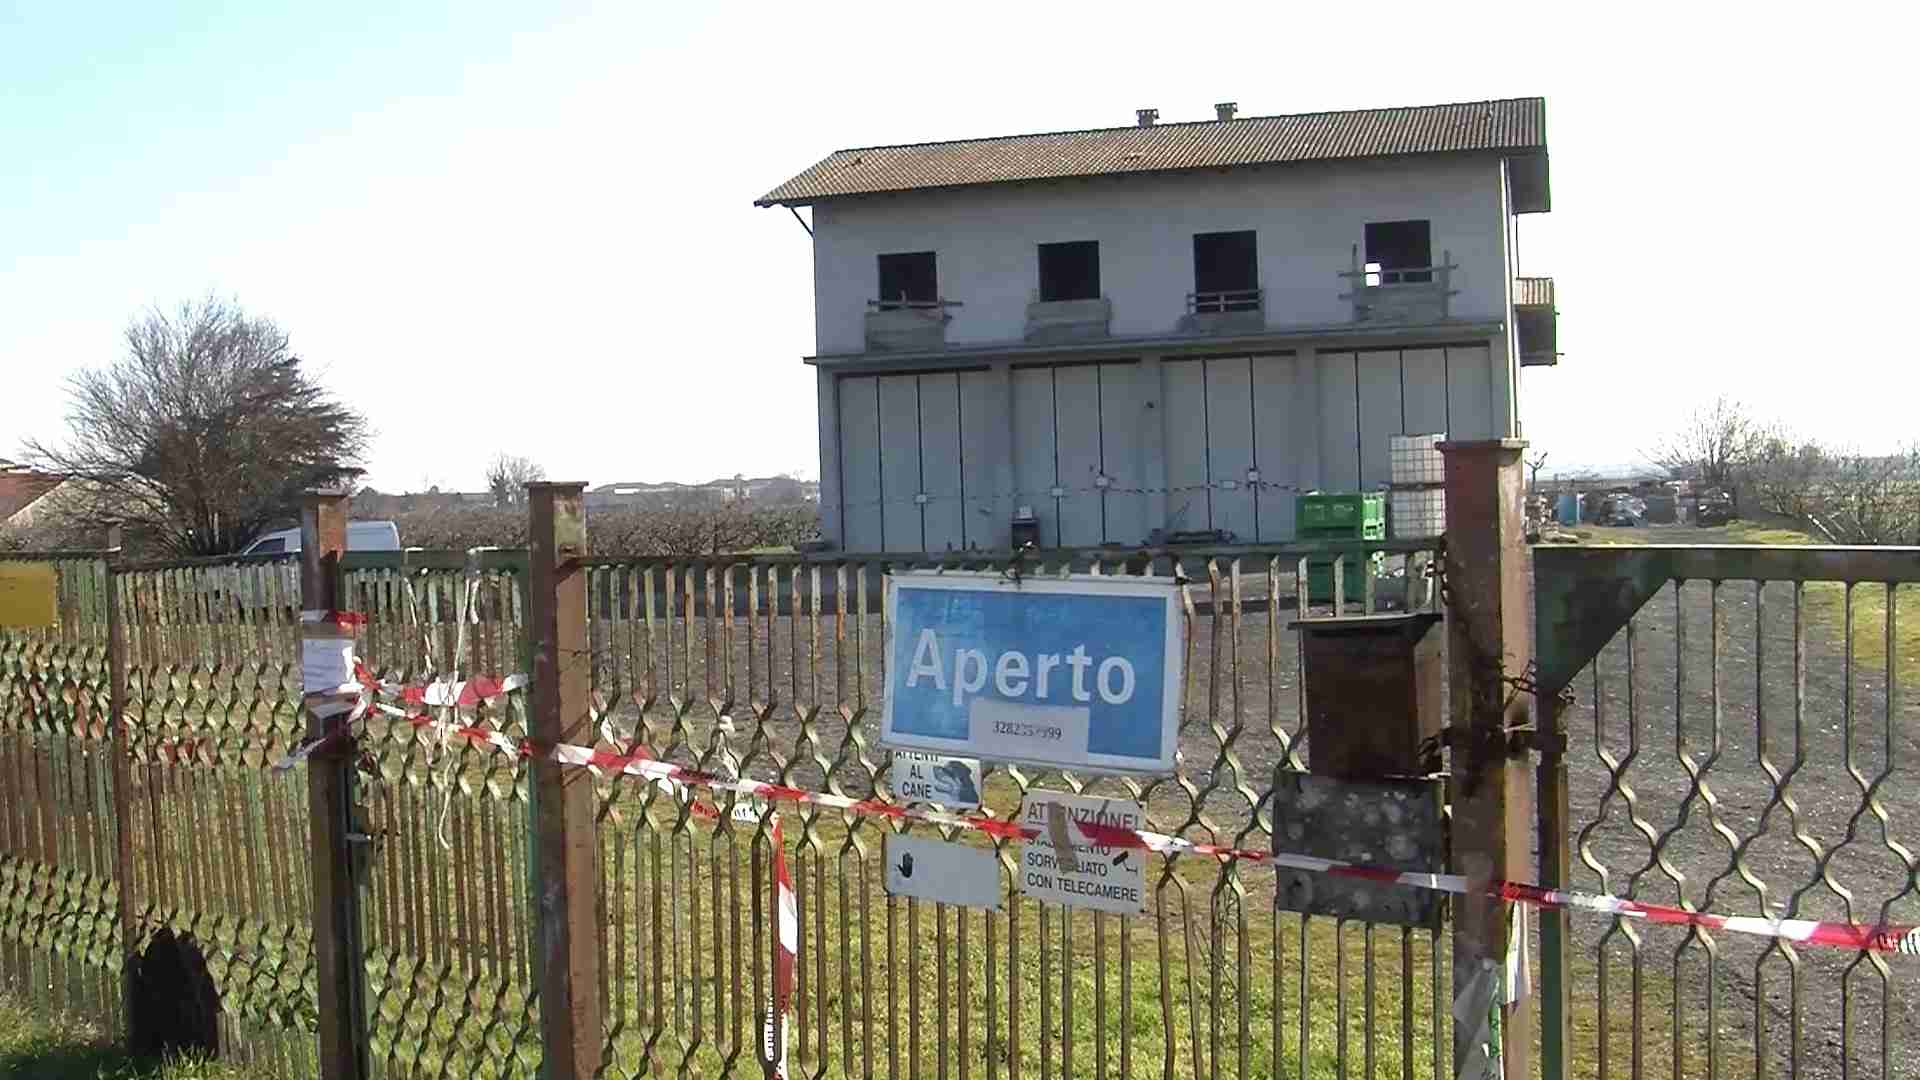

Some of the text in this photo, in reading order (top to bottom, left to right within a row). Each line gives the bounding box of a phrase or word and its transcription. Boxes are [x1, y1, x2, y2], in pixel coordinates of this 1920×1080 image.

[906, 627, 1137, 706] Aperto
[911, 763, 925, 781] AL
[902, 781, 932, 799] CANE
[1026, 872, 1139, 902] CON TELECAMERE
